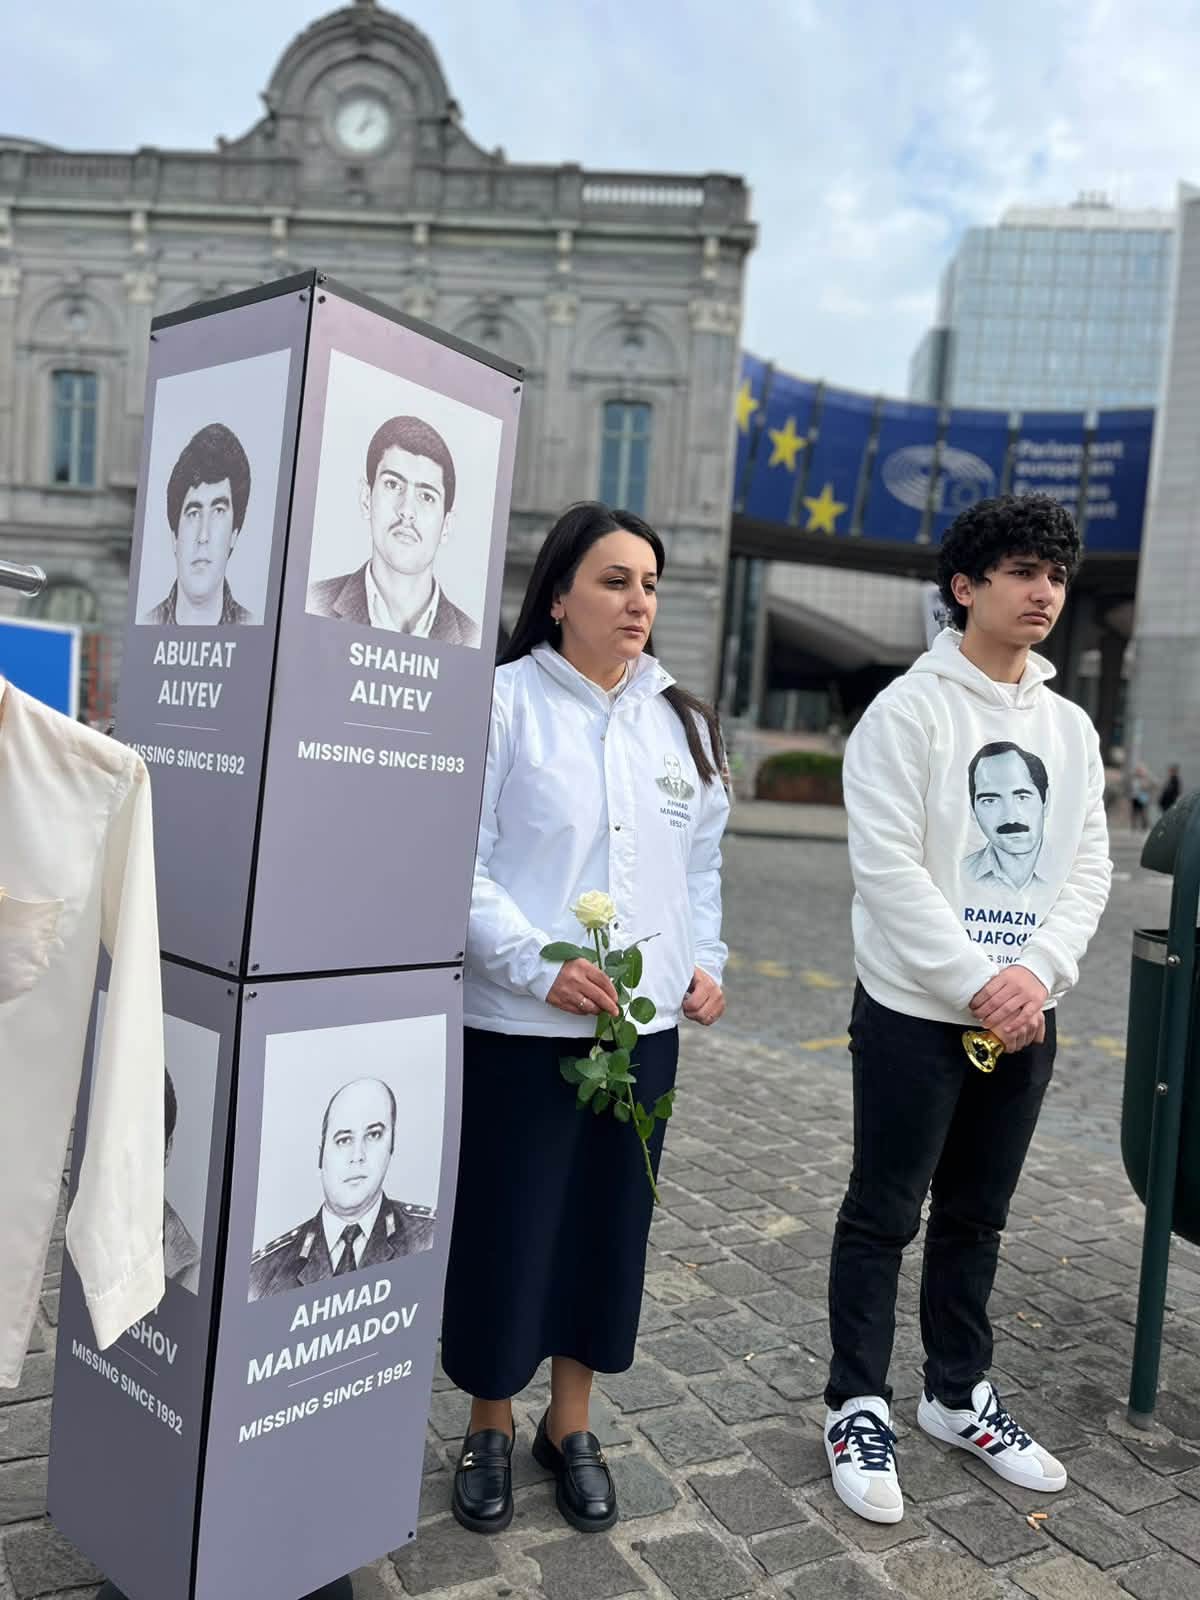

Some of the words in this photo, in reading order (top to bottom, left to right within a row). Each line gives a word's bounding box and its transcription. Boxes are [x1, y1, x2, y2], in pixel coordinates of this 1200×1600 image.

[153, 640, 237, 668] ABULFAT
[349, 642, 440, 679] SHAHIN
[157, 679, 223, 709] ALIYEV
[349, 679, 432, 713] ALIYEV
[176, 748, 214, 769] SINCE
[215, 754, 246, 776] 1992
[297, 740, 376, 765] MISSING
[378, 749, 429, 771] SINCE
[430, 754, 466, 774] 1993
[964, 907, 1037, 926] RAMAZN
[289, 1278, 392, 1333] AHMAD
[246, 1302, 420, 1385] MAMMADOV
[71, 1338, 119, 1384] MISSING
[120, 1373, 156, 1414] SINCE
[156, 1399, 183, 1436] 1992
[238, 1397, 320, 1444] MISSING
[322, 1374, 374, 1409] SINCE
[376, 1359, 414, 1388] 1992
